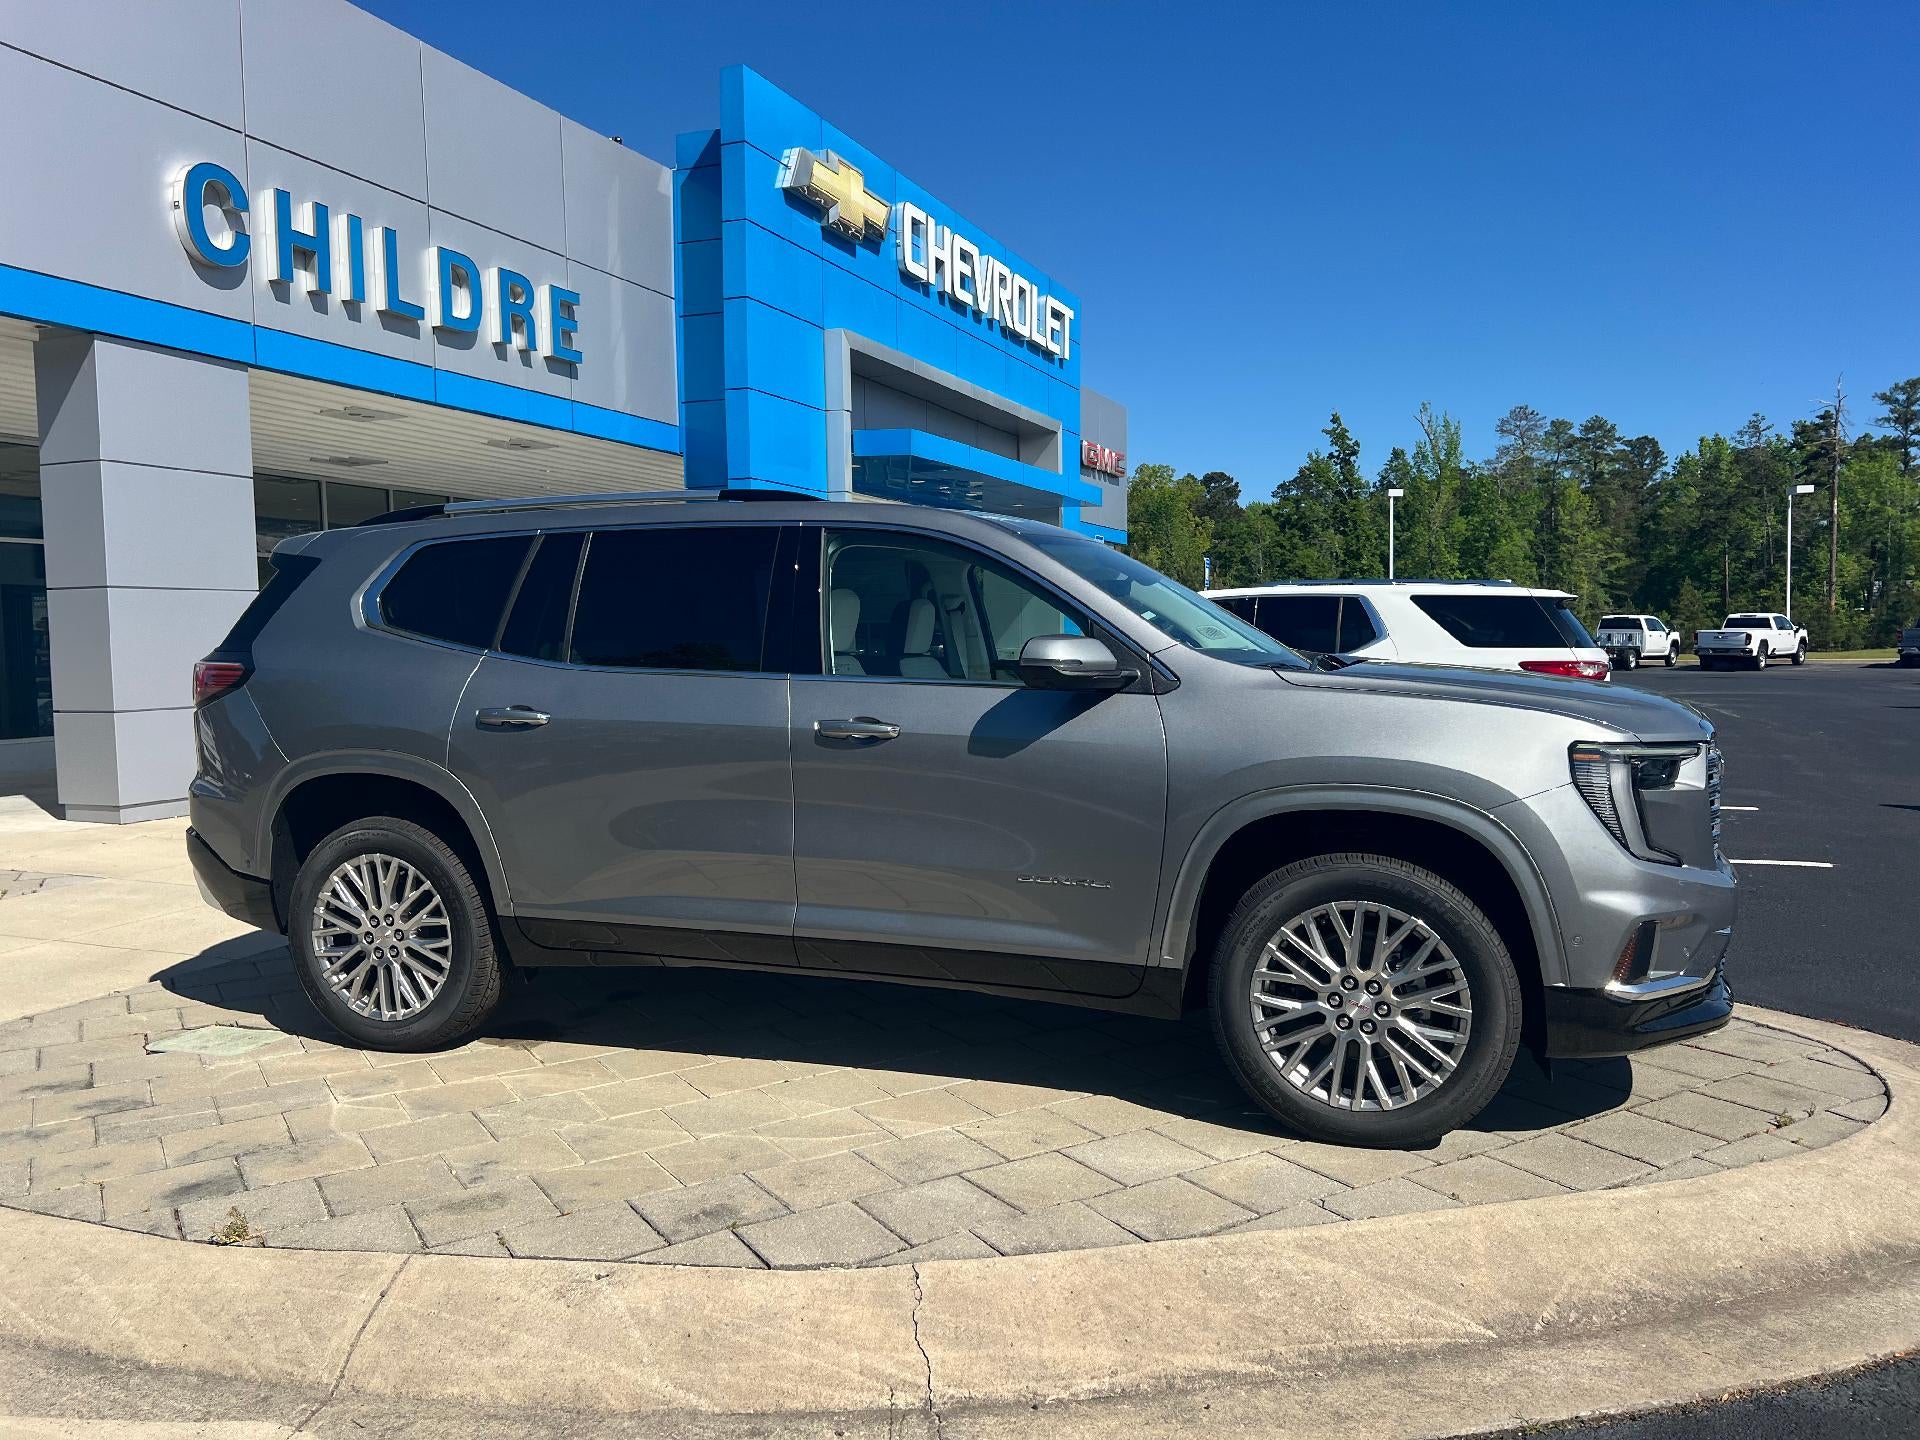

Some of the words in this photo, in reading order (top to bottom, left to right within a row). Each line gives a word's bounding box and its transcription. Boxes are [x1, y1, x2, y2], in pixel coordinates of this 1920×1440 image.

[175, 161, 583, 364] CHILDRE
[897, 200, 1075, 361] CHEVROLET
[1081, 440, 1125, 477] GMC
